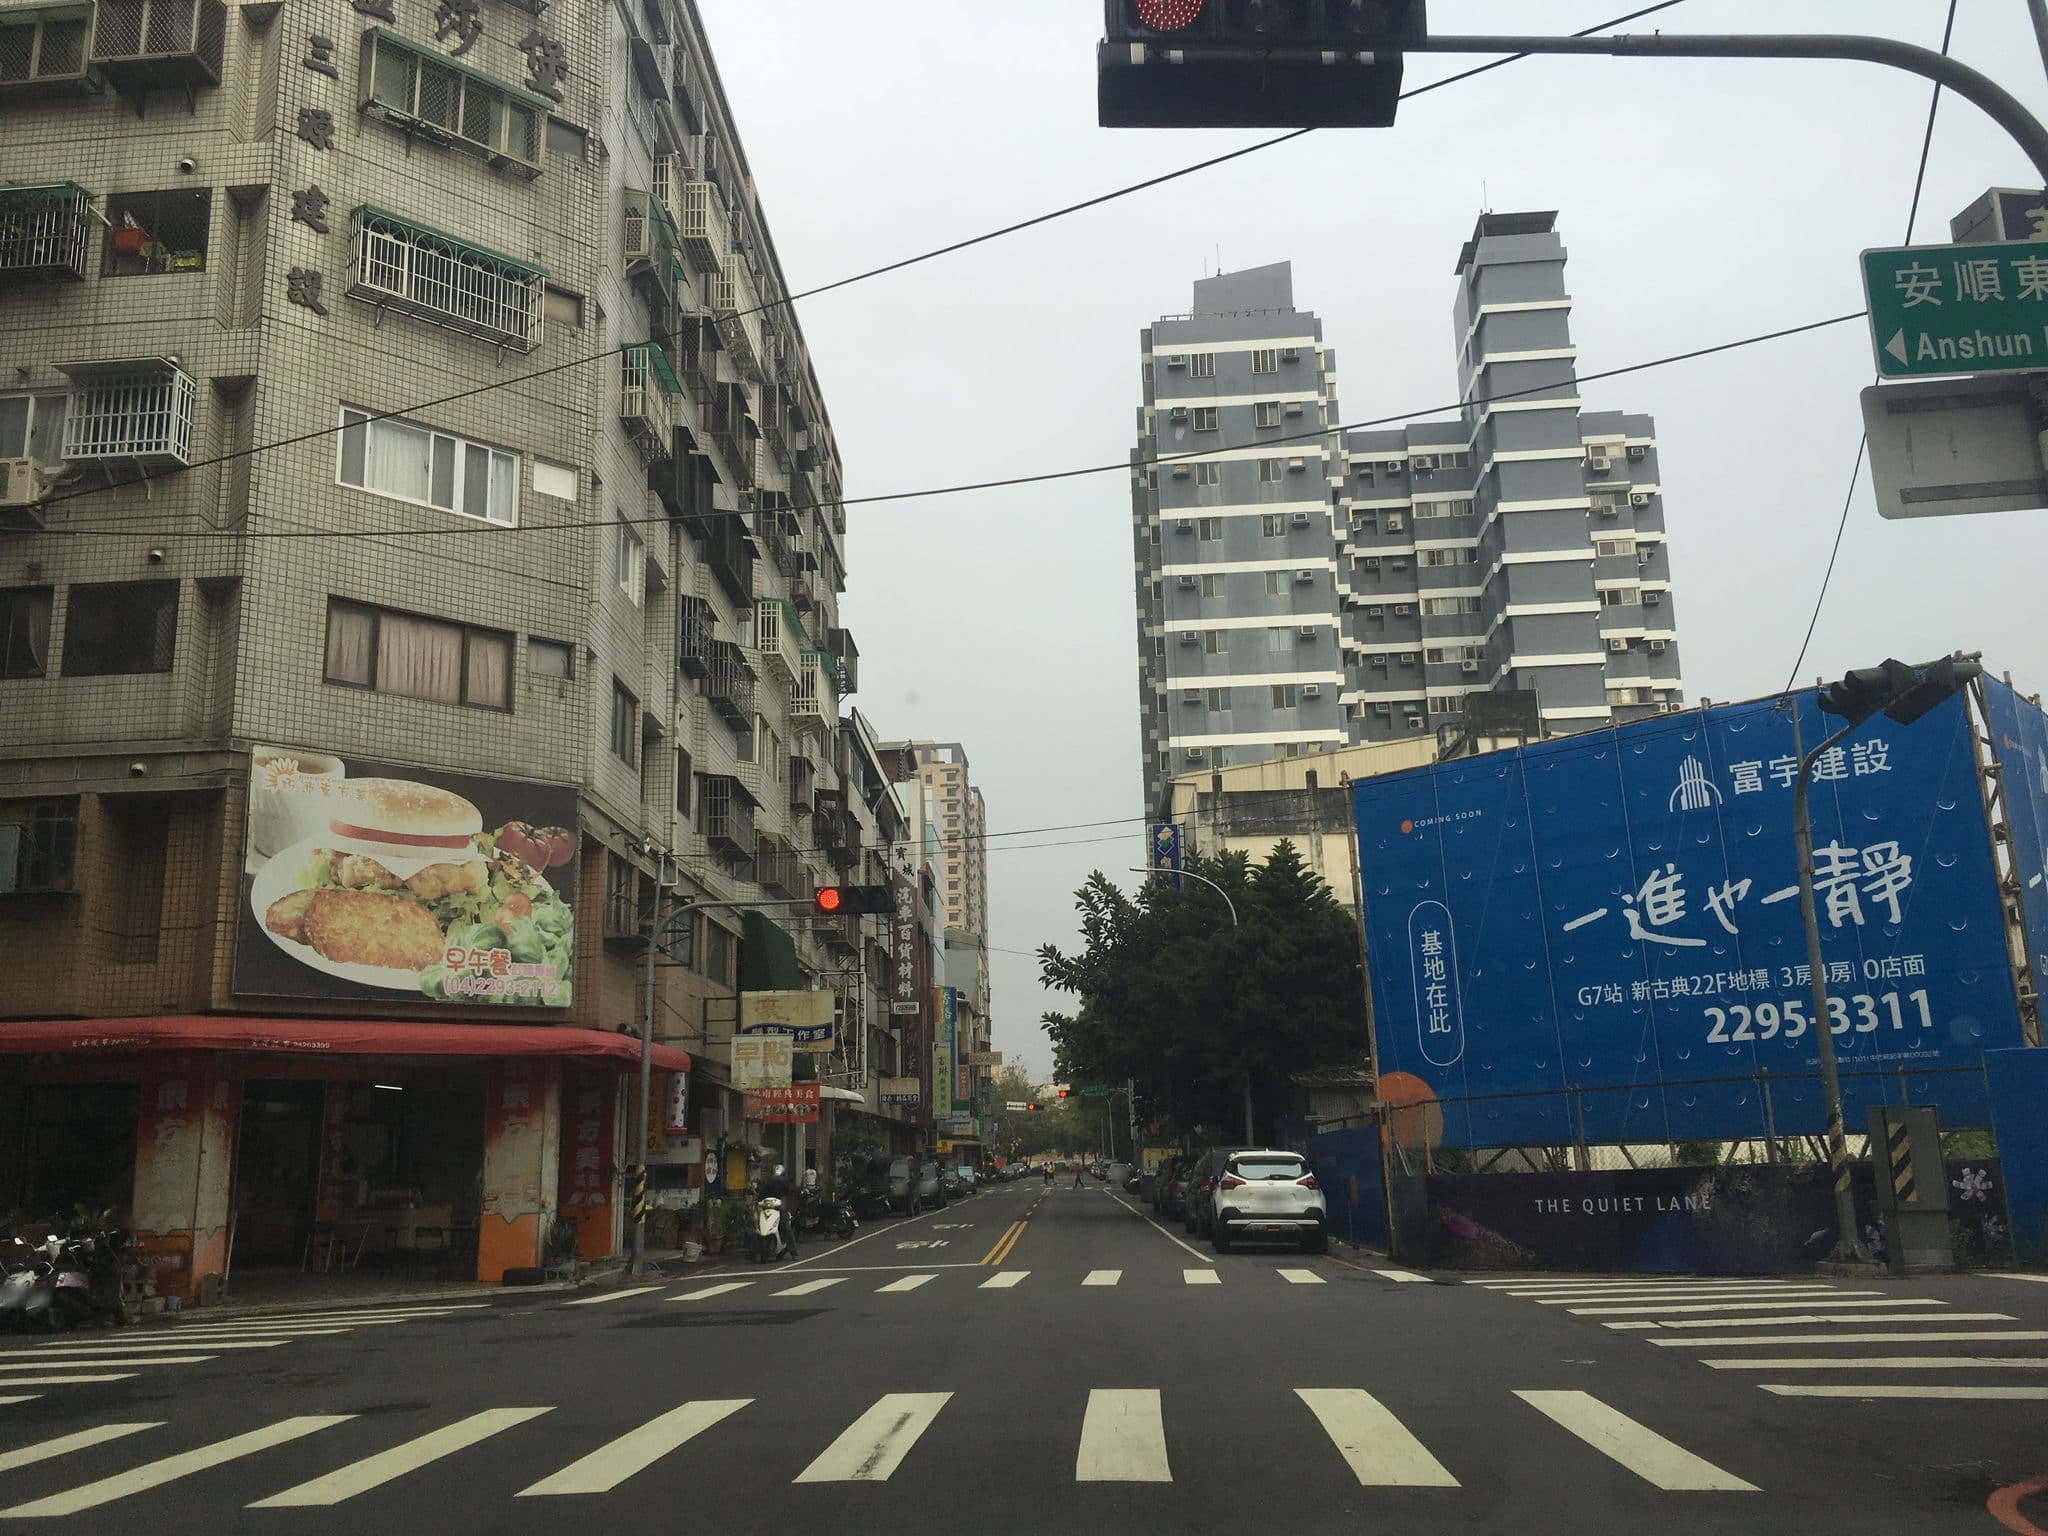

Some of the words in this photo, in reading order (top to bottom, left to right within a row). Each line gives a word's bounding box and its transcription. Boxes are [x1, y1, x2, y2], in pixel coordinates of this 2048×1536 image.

[1894, 254, 2048, 308] 安順東
[1916, 329, 2033, 361] Anshun
[1728, 738, 1893, 796] 富宇建設
[1414, 814, 1452, 828] COMING
[1455, 809, 1482, 821] SOON
[446, 948, 511, 977] 早午餐
[1421, 929, 1452, 1033] 基地在此
[1577, 983, 1623, 1007] G7站
[1631, 971, 1770, 1001] 新古典22F地標
[1703, 989, 1934, 1044] 2295-3311
[1534, 1198, 1571, 1213] THE
[1582, 1196, 1644, 1215] QUIET
[1656, 1194, 1712, 1212] LANE
